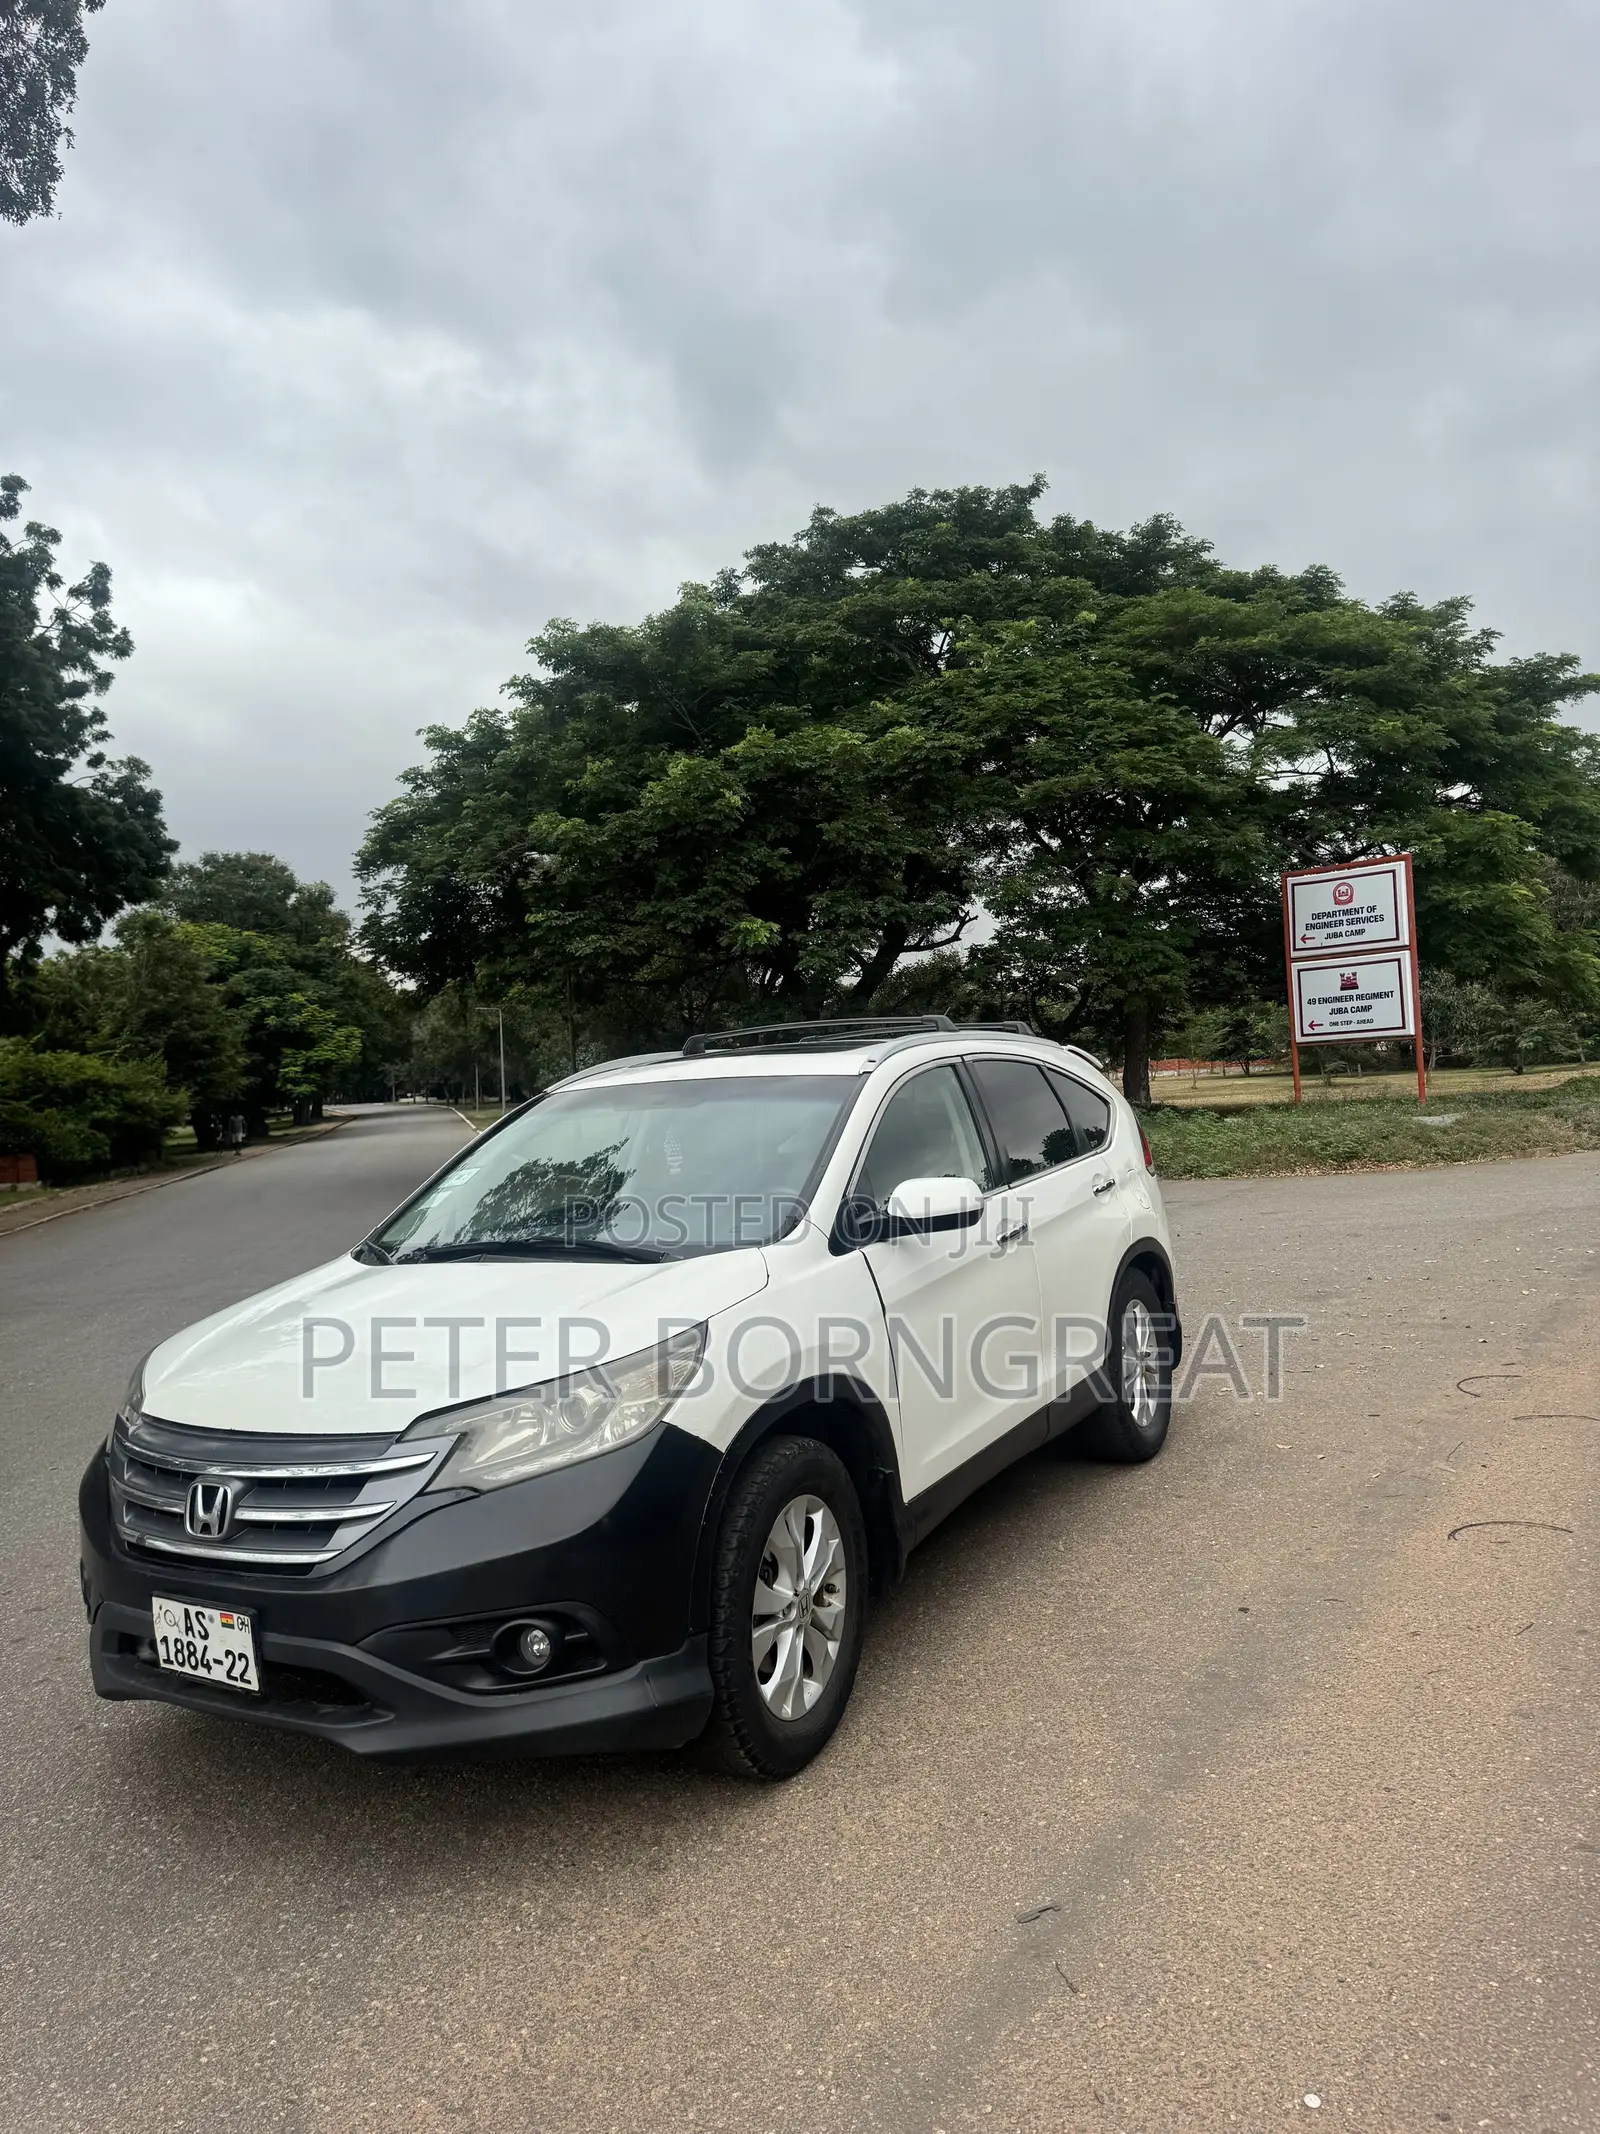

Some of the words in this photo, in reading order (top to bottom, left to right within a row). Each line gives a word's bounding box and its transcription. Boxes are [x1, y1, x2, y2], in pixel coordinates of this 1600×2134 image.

[1311, 906, 1365, 921] DEPARTMENT
[1366, 904, 1377, 915] OF
[1305, 918, 1345, 931] ENGINEER
[1345, 914, 1385, 927] SERVICES
[1324, 931, 1344, 940] JUBA
[1345, 929, 1366, 938] CAMP
[1306, 997, 1317, 1006] 49
[1317, 994, 1355, 1005] ENGINEER
[1355, 990, 1395, 1003] REGIMENT
[1329, 1006, 1349, 1016] JUBA
[1350, 1004, 1373, 1014] CAMP
[183, 1607, 210, 1641] AS
[236, 1616, 251, 1635] GH
[159, 1635, 252, 1685] 1884-22
